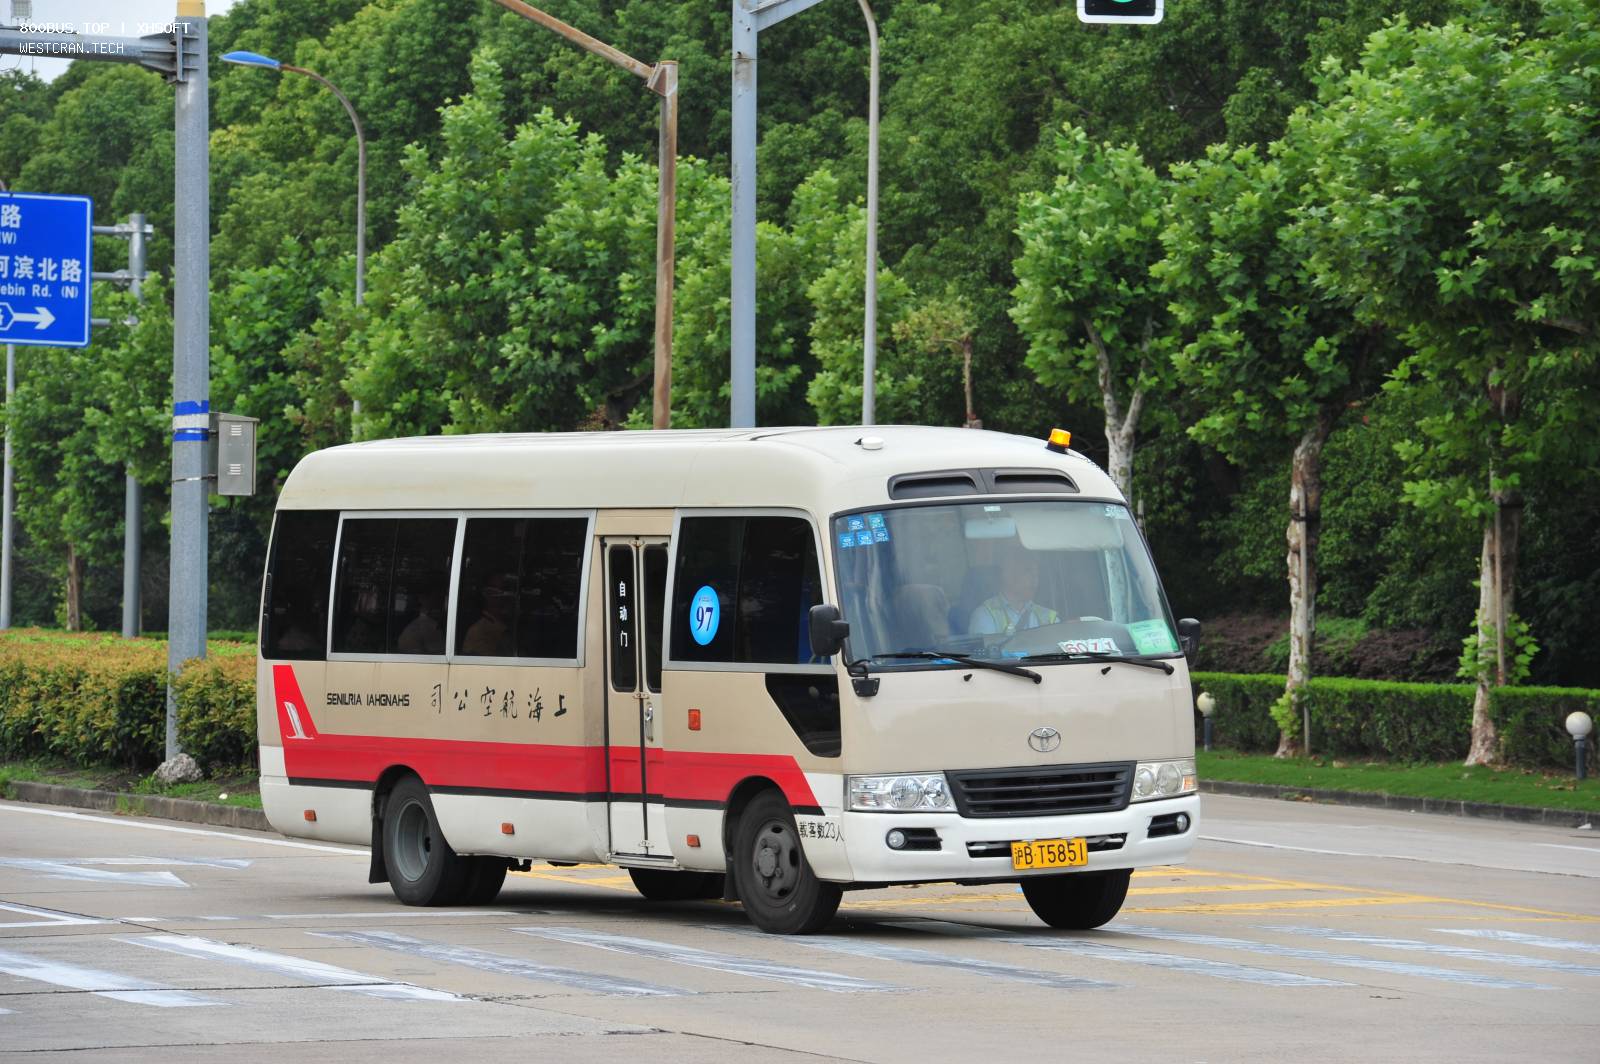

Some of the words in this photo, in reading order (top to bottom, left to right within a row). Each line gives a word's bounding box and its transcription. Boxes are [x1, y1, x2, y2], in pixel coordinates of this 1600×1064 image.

[0, 204, 21, 229] 路
[0, 283, 25, 297] ebin
[32, 285, 52, 297] Rd.
[61, 286, 78, 299] (N)
[619, 581, 628, 648] 自动门
[696, 606, 713, 632] 97
